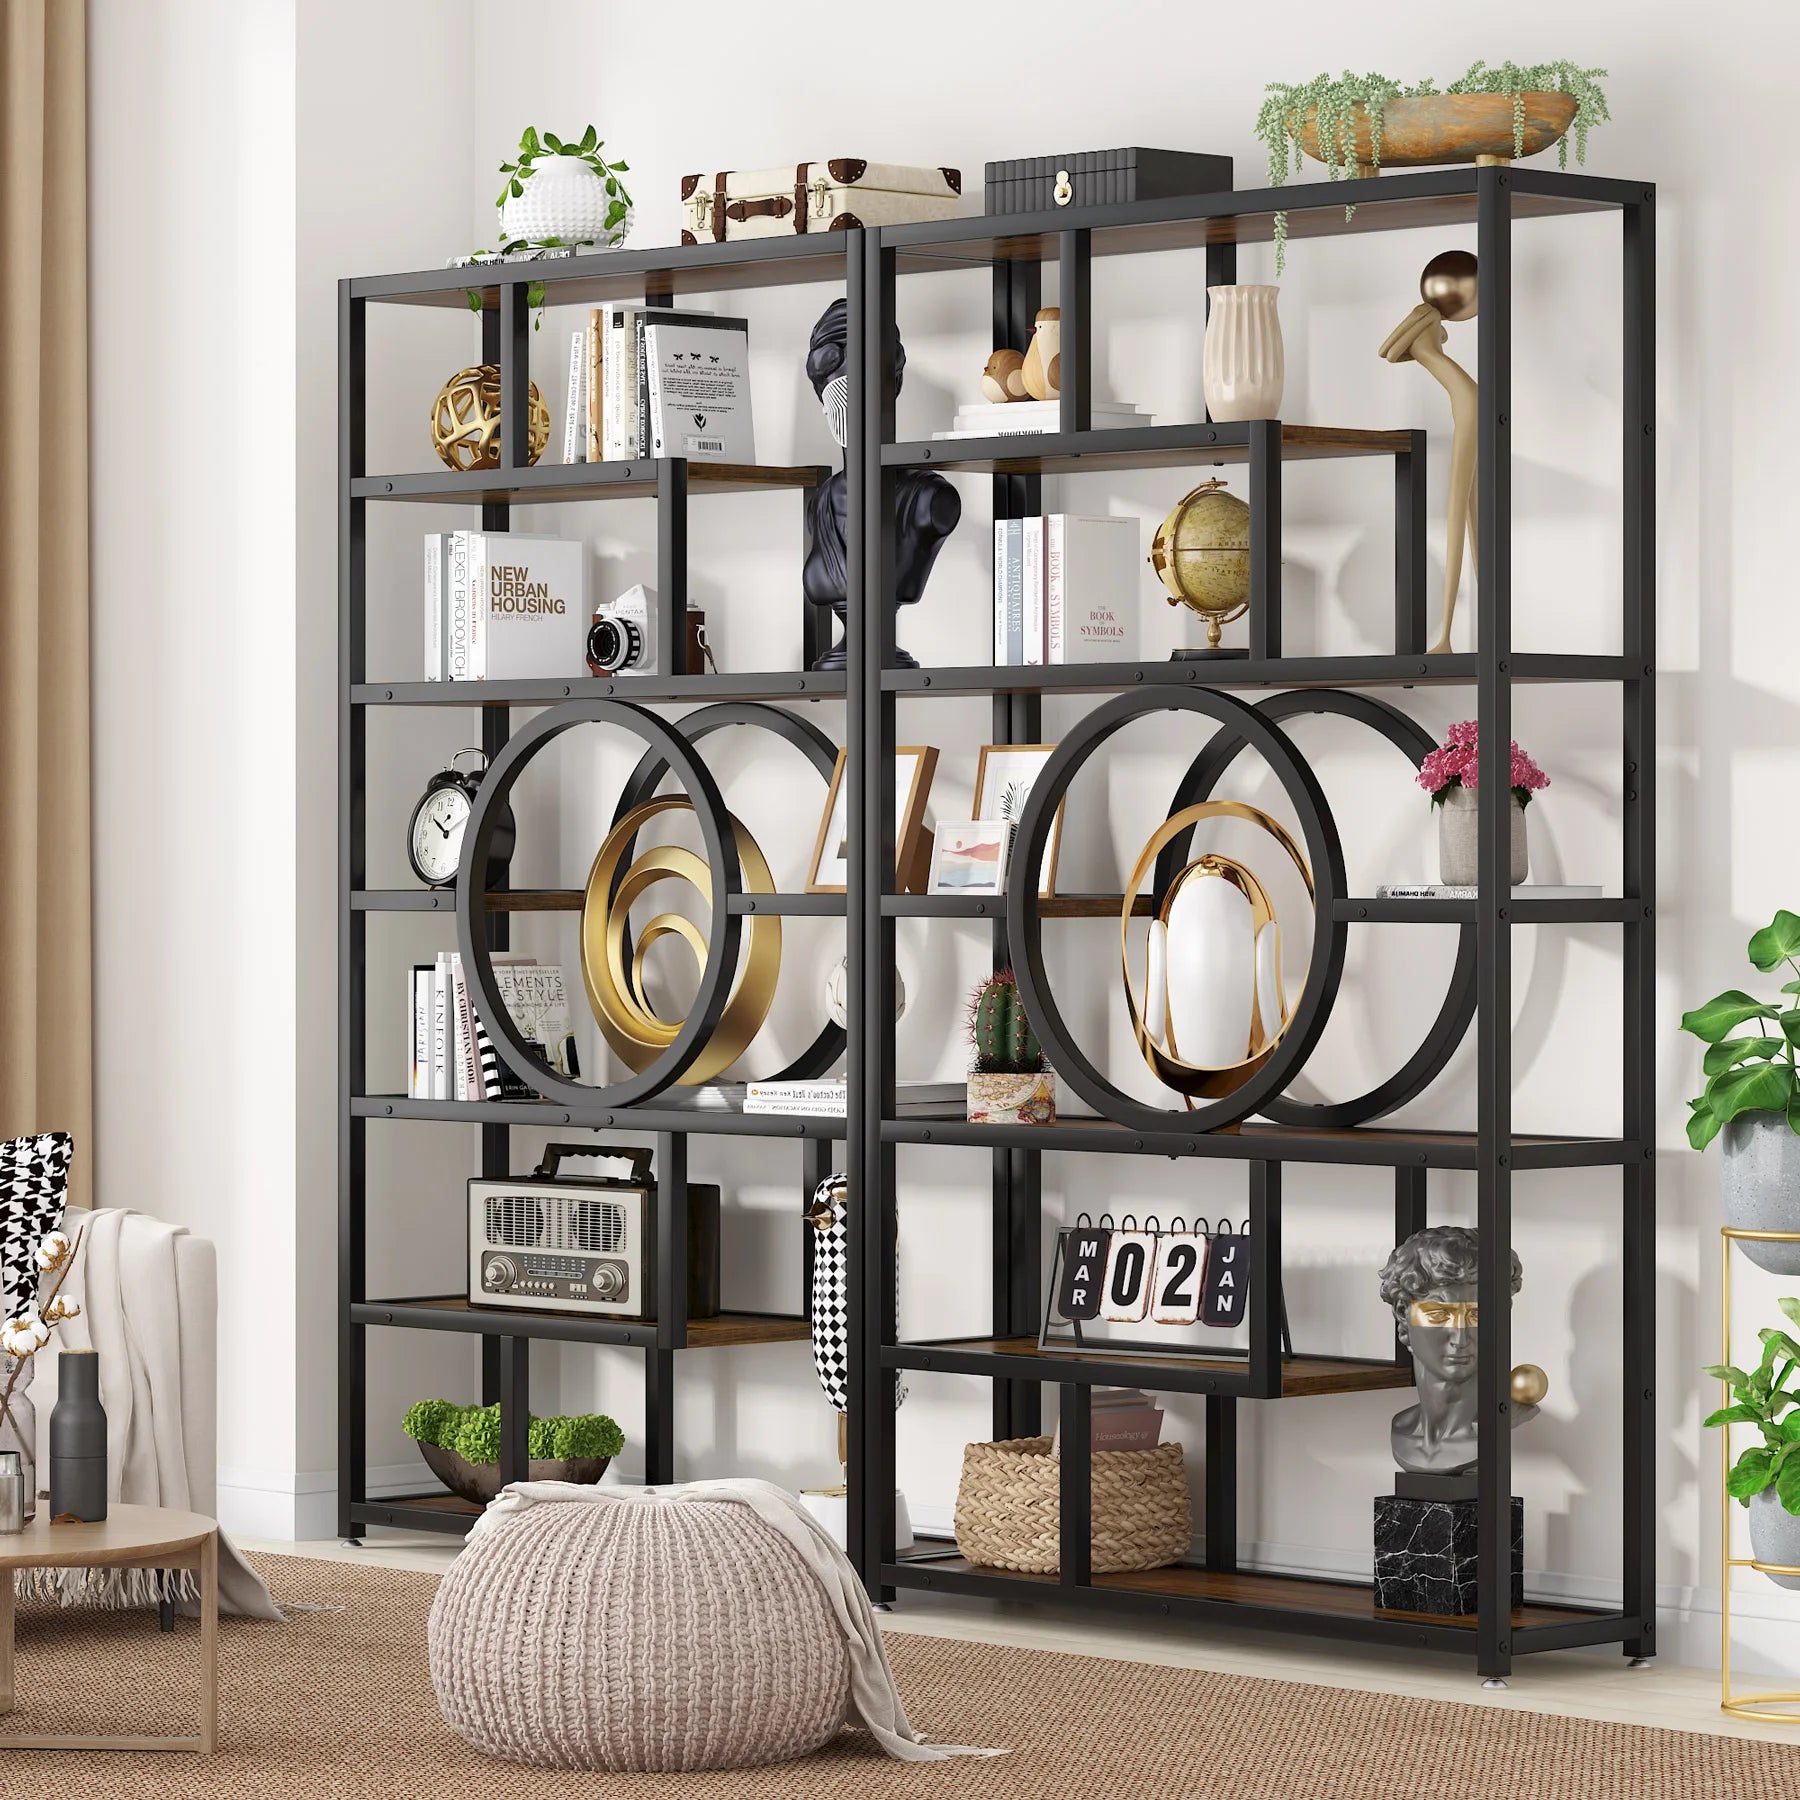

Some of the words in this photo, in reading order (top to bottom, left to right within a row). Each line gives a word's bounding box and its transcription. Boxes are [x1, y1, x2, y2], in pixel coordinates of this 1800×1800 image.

[454, 534, 466, 586] ALEXEY
[1050, 551, 1060, 583] BOOK
[491, 566, 528, 582] NEW
[491, 582, 548, 598] URBAN
[1012, 557, 1021, 633] ANTIQUAIRES
[491, 597, 566, 615] HOUSING
[491, 613, 515, 621] HILARY
[1090, 611, 1115, 621] BOOK
[454, 590, 466, 677] BRODOVITCH
[1050, 594, 1060, 649] SYMBOLS
[1080, 625, 1124, 637] SYMBOLS
[456, 982, 466, 996] BY
[517, 989, 564, 1001] STYLE
[417, 1007, 428, 1063] PARISIAN
[435, 990, 444, 1075] KINFOLK
[459, 999, 472, 1054] CHRISTIAN
[466, 1057, 475, 1084] DIOR
[1072, 1241, 1098, 1306] MAR
[1216, 1246, 1236, 1312] JAN
[1095, 1430, 1139, 1441] Houseology
